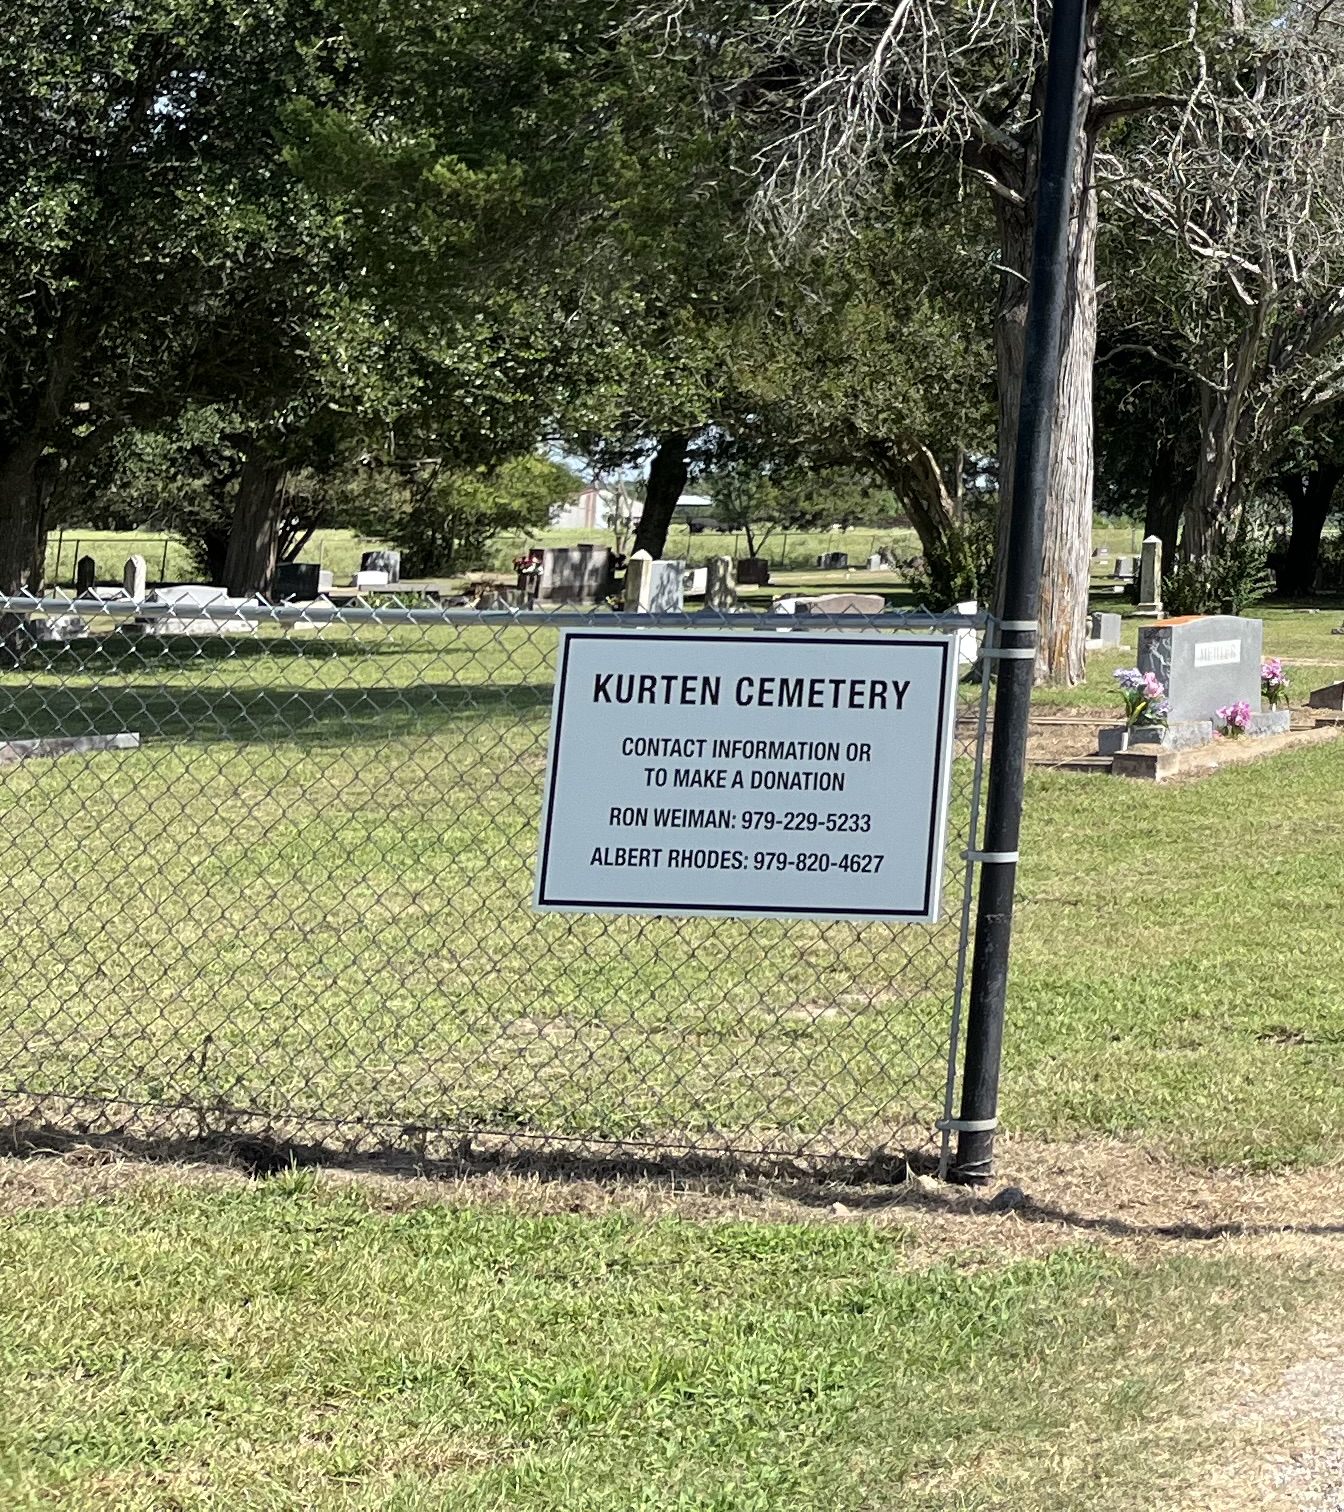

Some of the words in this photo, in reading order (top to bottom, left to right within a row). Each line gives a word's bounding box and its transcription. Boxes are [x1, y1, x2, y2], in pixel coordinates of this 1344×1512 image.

[594, 674, 720, 705] KURTEN
[736, 677, 910, 709] CEMETERY
[623, 738, 707, 758] CONTACT
[713, 740, 839, 760] INFORMATION
[847, 743, 870, 761] OR
[645, 768, 667, 786] TO
[674, 769, 726, 788] MAKE
[731, 771, 743, 788] A
[751, 771, 844, 791] DONATION
[610, 808, 648, 826] RON
[654, 809, 736, 828] WEIMAN:
[742, 811, 870, 832] 979-229-5233
[590, 848, 662, 867] ALBERT
[668, 850, 748, 869] RHODES:
[754, 852, 884, 873] 979-820-4627
